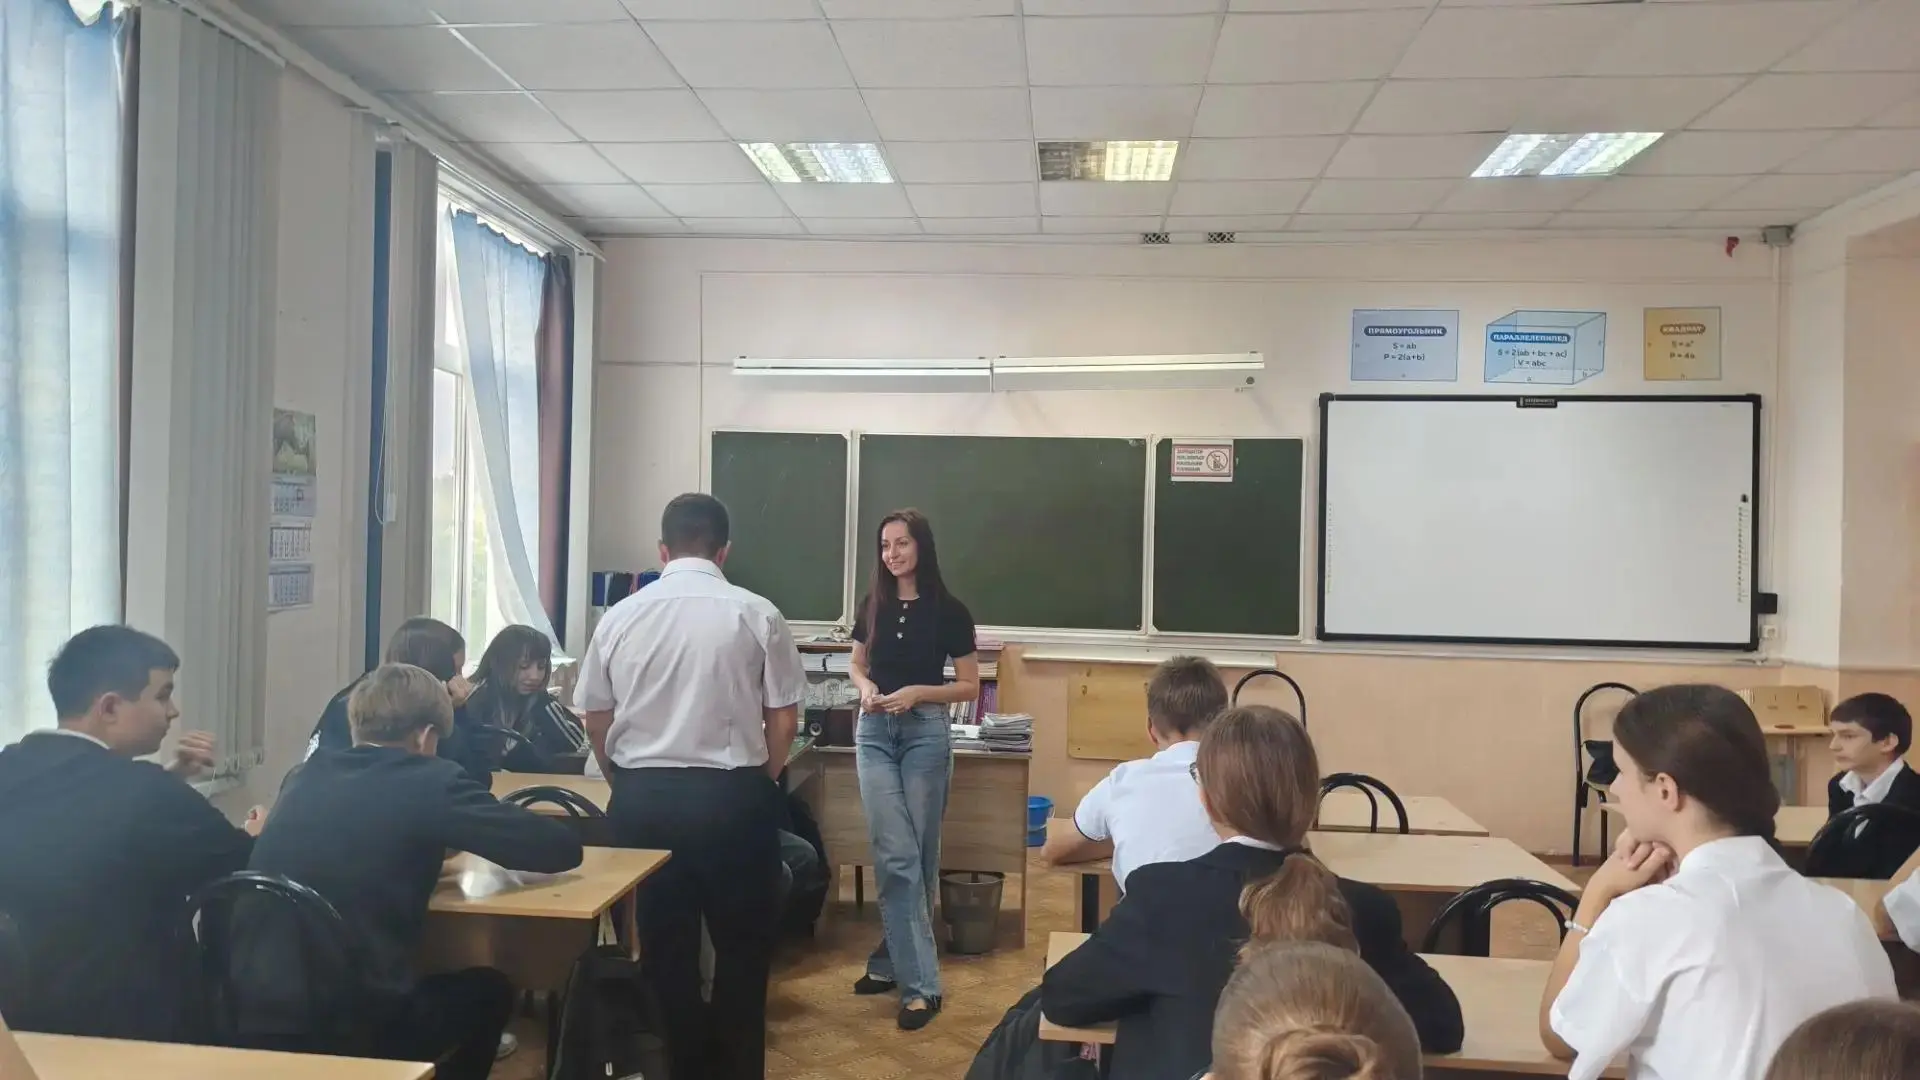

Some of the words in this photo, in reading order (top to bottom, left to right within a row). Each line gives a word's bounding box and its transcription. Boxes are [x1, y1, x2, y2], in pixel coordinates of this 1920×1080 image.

[1367, 327, 1444, 335] ПРЯМОУГОЛЬНИК
[1493, 333, 1568, 342] ПАРАЛЛЕЛЕПИПЕД
[1531, 359, 1547, 367] abc
